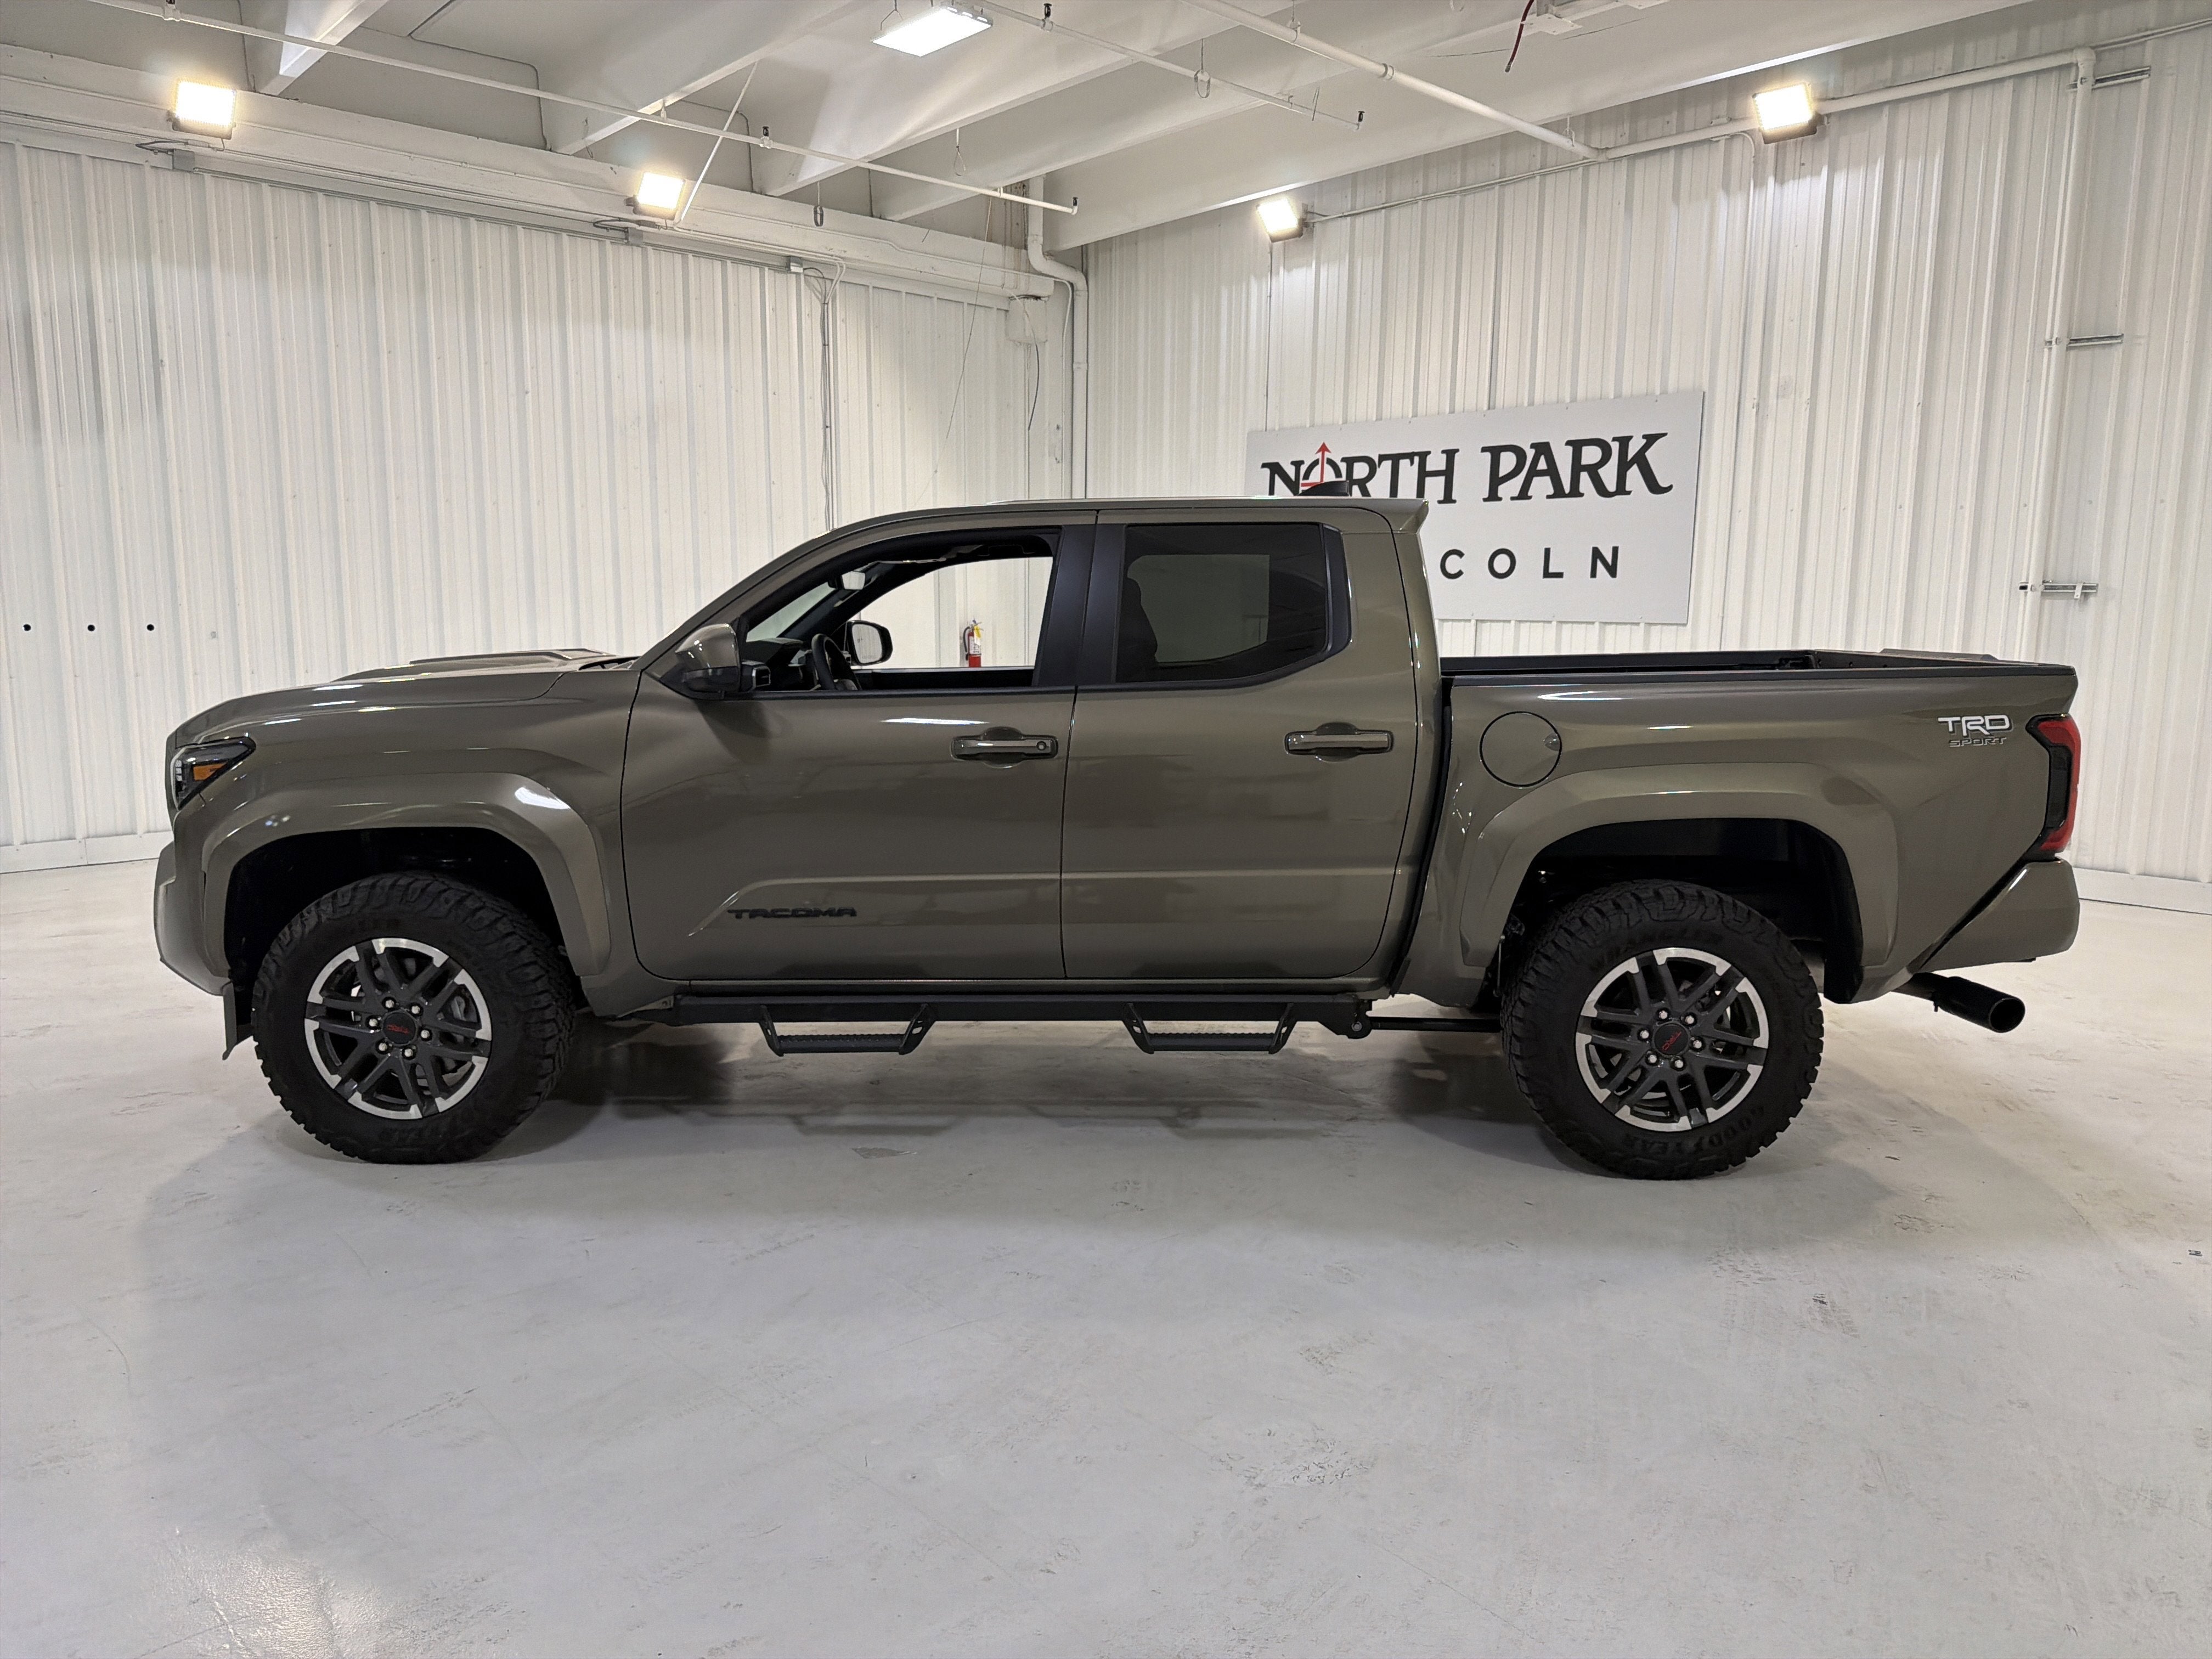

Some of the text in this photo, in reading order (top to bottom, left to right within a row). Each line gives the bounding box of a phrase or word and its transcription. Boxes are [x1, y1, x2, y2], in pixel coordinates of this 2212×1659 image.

[1261, 432, 1673, 504] NORTH PARK
[1440, 546, 1619, 580] COLN
[1937, 714, 2011, 737] TRD
[1949, 737, 2007, 747] SPORT
[727, 907, 857, 919] TACOMA
